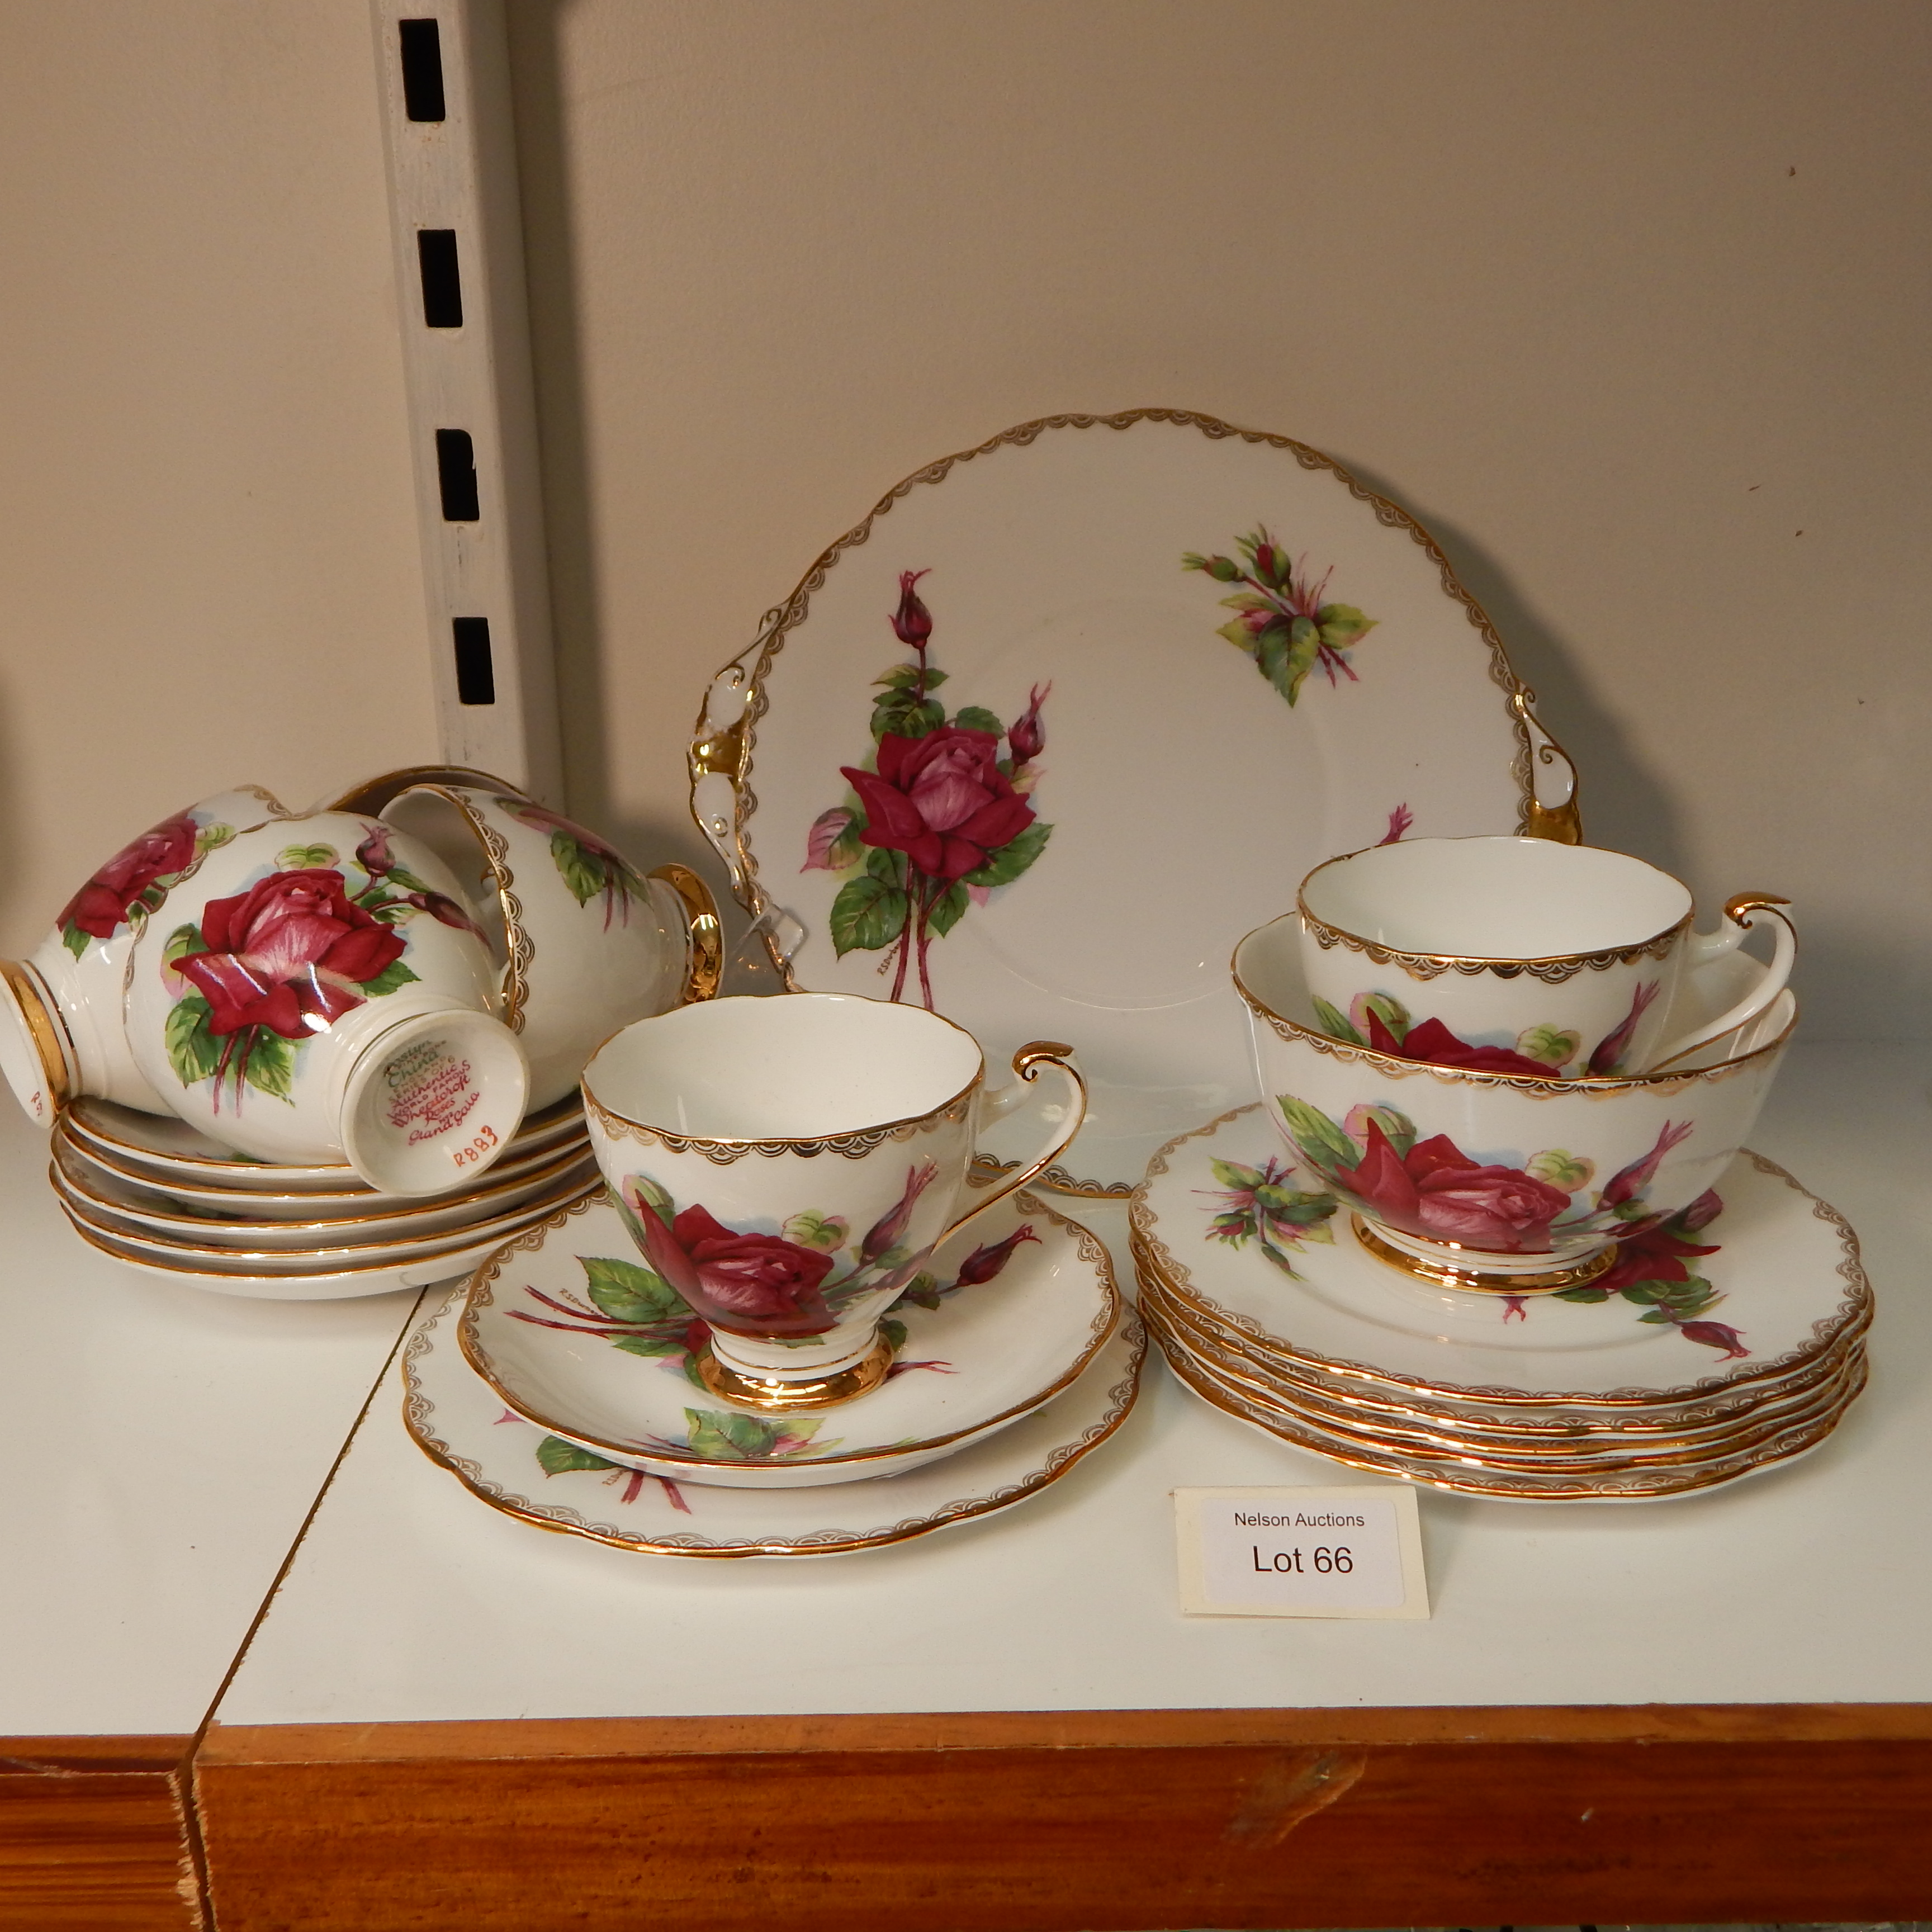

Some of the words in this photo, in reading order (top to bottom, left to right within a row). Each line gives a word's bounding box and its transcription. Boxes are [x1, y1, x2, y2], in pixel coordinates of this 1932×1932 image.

[388, 1052, 439, 1088] China
[387, 1094, 429, 1120] WORLD
[432, 1059, 471, 1093] FAMOUS
[389, 1076, 427, 1103] SERIES
[453, 1124, 499, 1168] R883
[1234, 1512, 1290, 1527] Nelson
[1295, 1512, 1365, 1527] Auctions
[1252, 1545, 1304, 1573] Lot
[1314, 1546, 1353, 1574] 66
